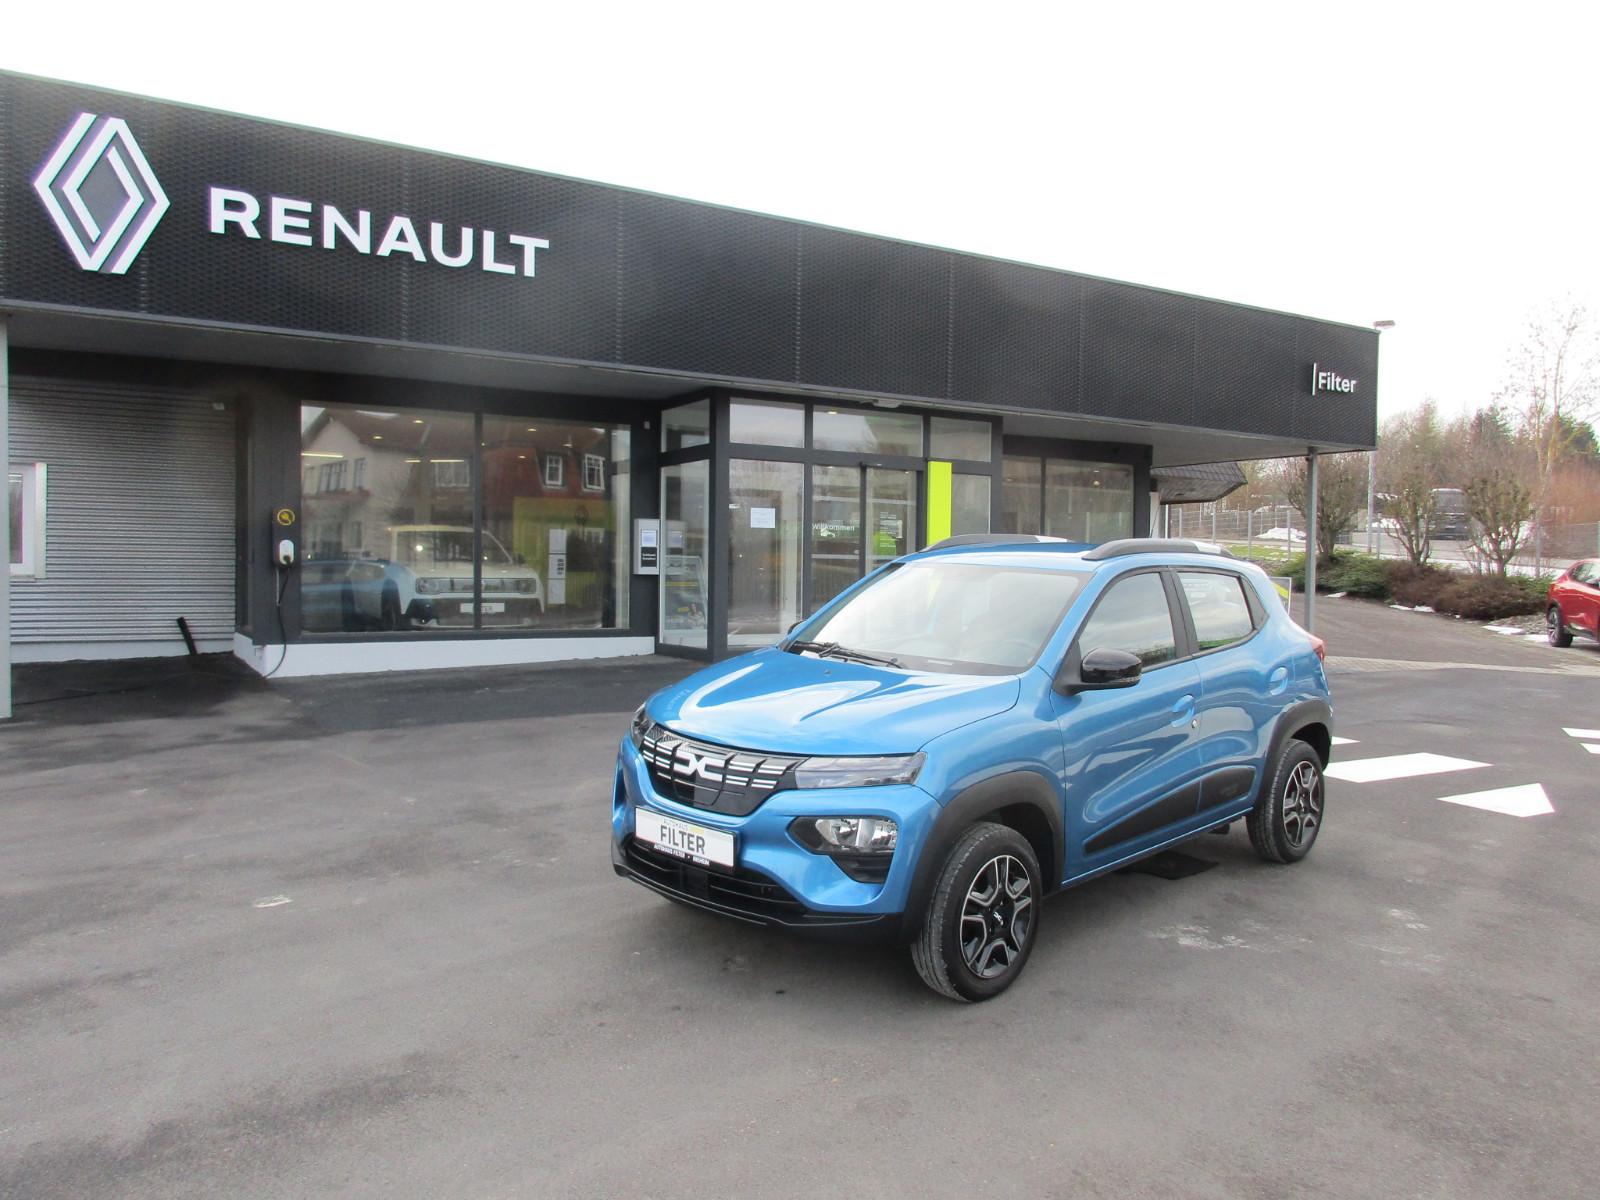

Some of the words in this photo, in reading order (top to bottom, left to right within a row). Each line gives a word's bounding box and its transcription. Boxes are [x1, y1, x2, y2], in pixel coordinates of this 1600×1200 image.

[210, 186, 550, 278] RENAULT
[1318, 371, 1357, 393] Filter
[660, 824, 706, 855] FILTER
